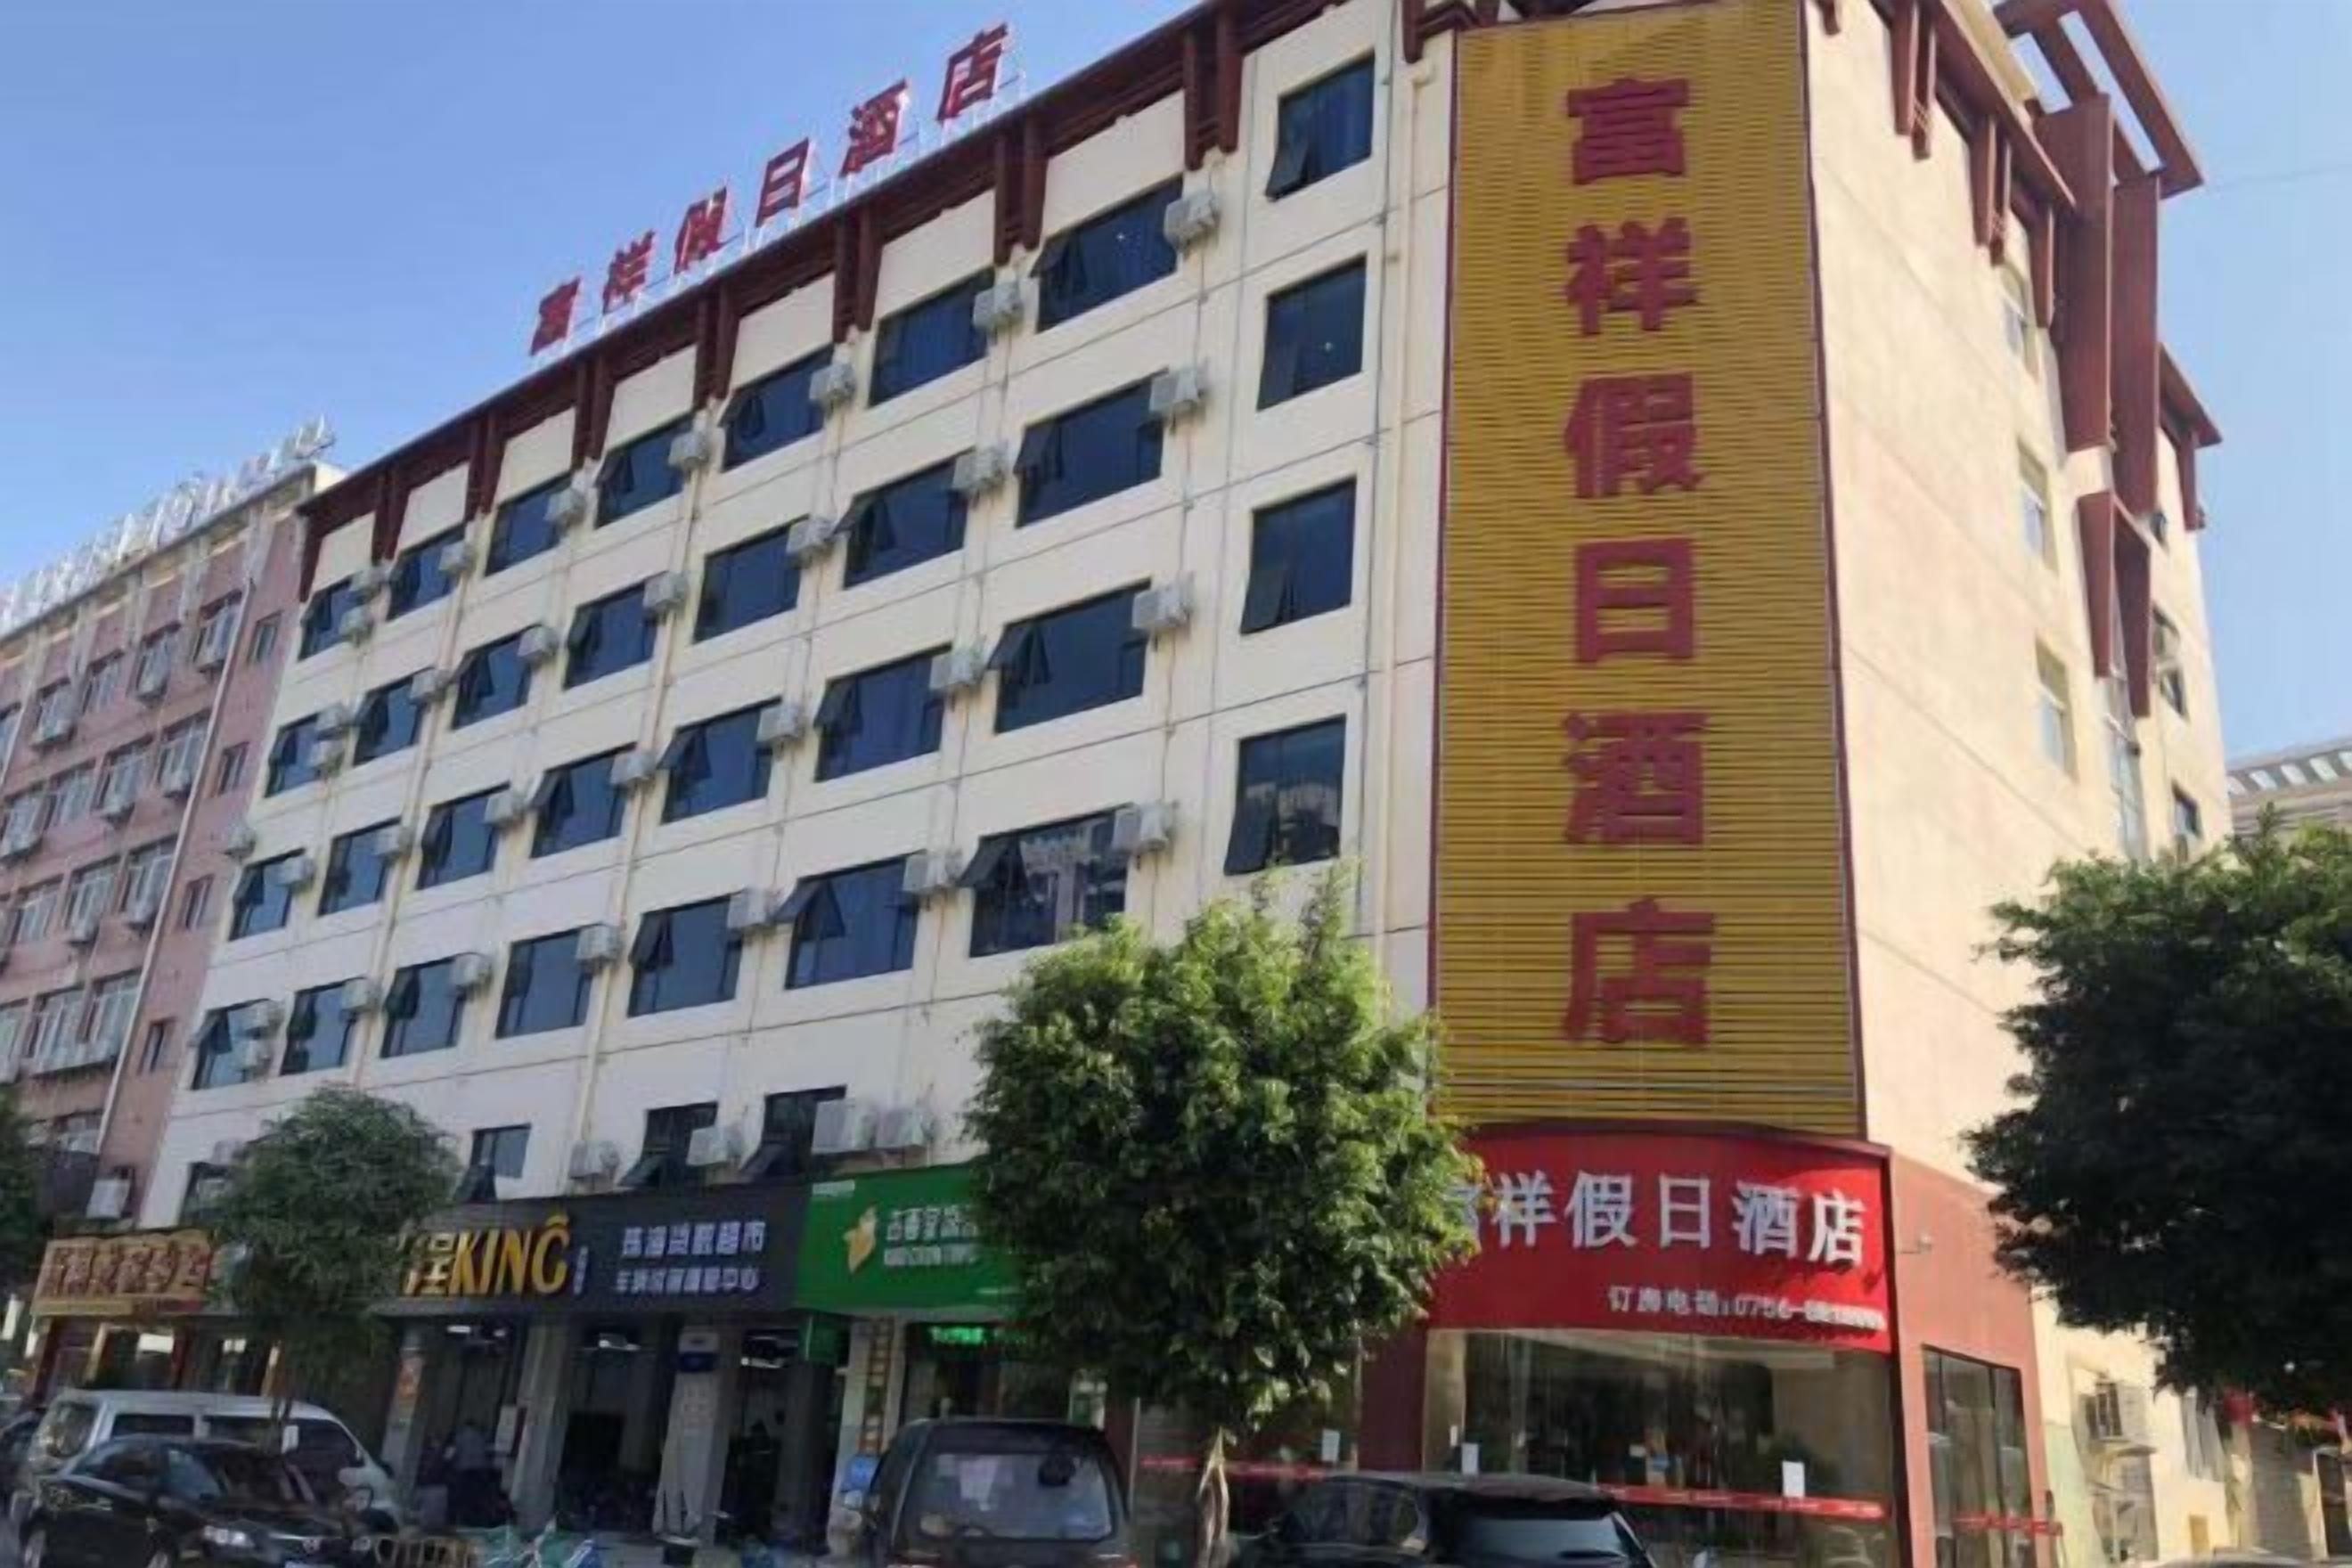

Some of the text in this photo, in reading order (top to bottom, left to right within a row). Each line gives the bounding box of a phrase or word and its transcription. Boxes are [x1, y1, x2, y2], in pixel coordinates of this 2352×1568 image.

[531, 22, 1011, 357] 富祥假日酒店
[1561, 77, 1715, 1049] 富祥假日酒店
